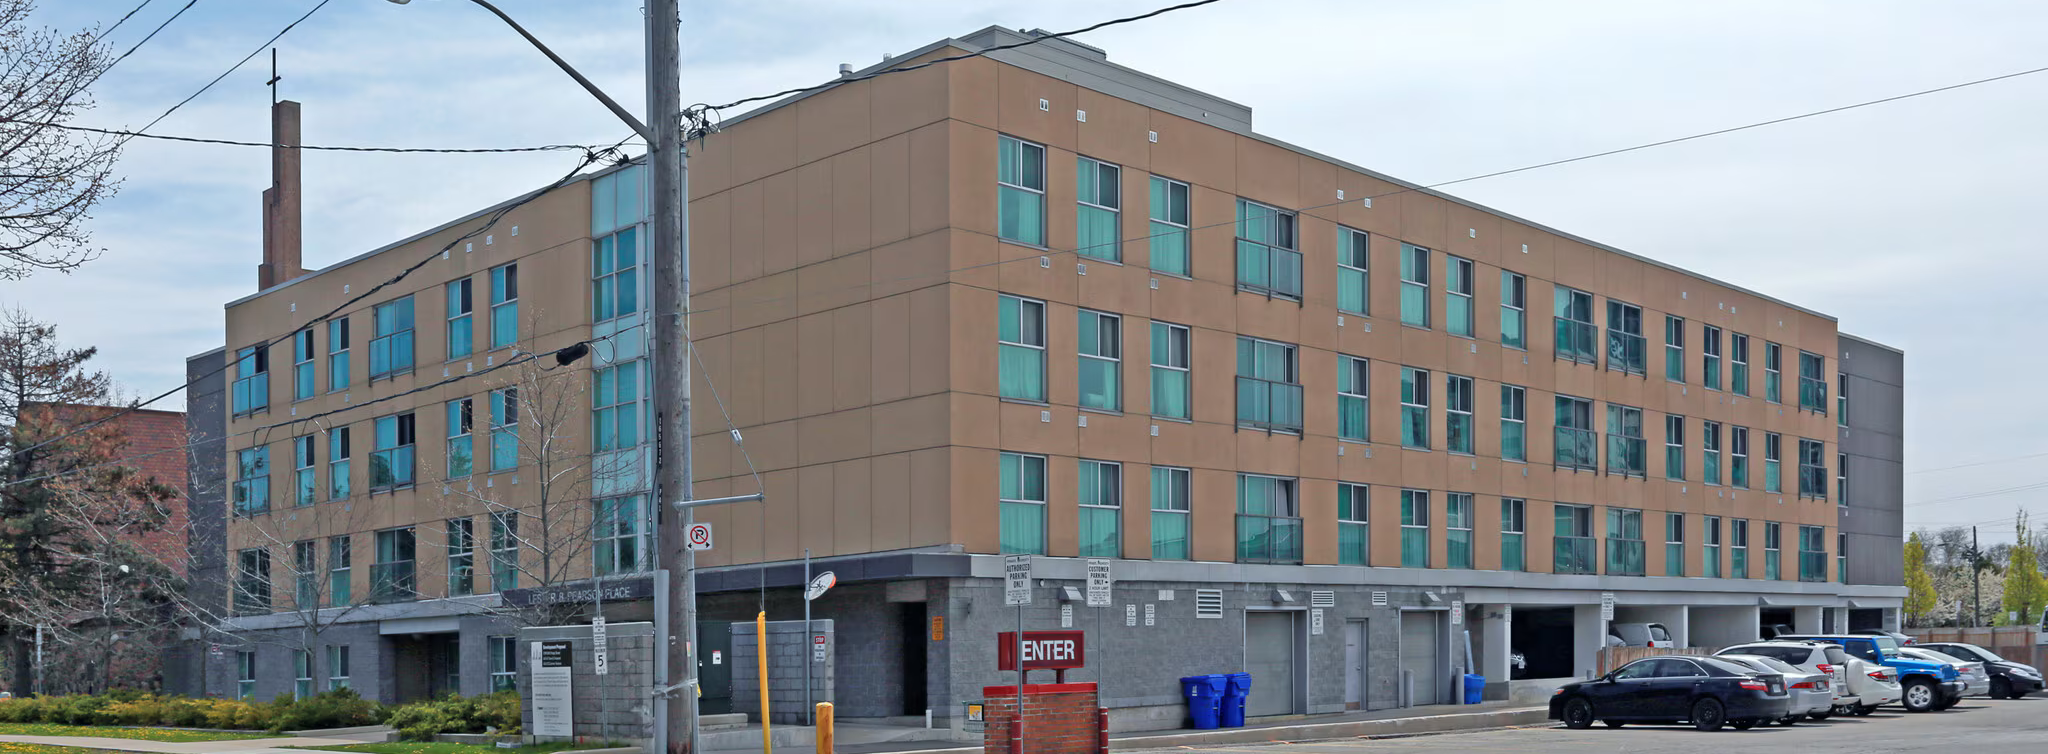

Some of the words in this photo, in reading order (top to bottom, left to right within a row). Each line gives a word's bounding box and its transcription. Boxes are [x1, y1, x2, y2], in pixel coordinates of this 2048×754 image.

[1007, 563, 1030, 573] AUTHORIZED
[1009, 571, 1028, 580] PARKING
[1013, 580, 1024, 589] ONLY
[604, 586, 631, 599] PLACE
[1022, 640, 1075, 661] ENTER
[598, 654, 604, 667] 5
